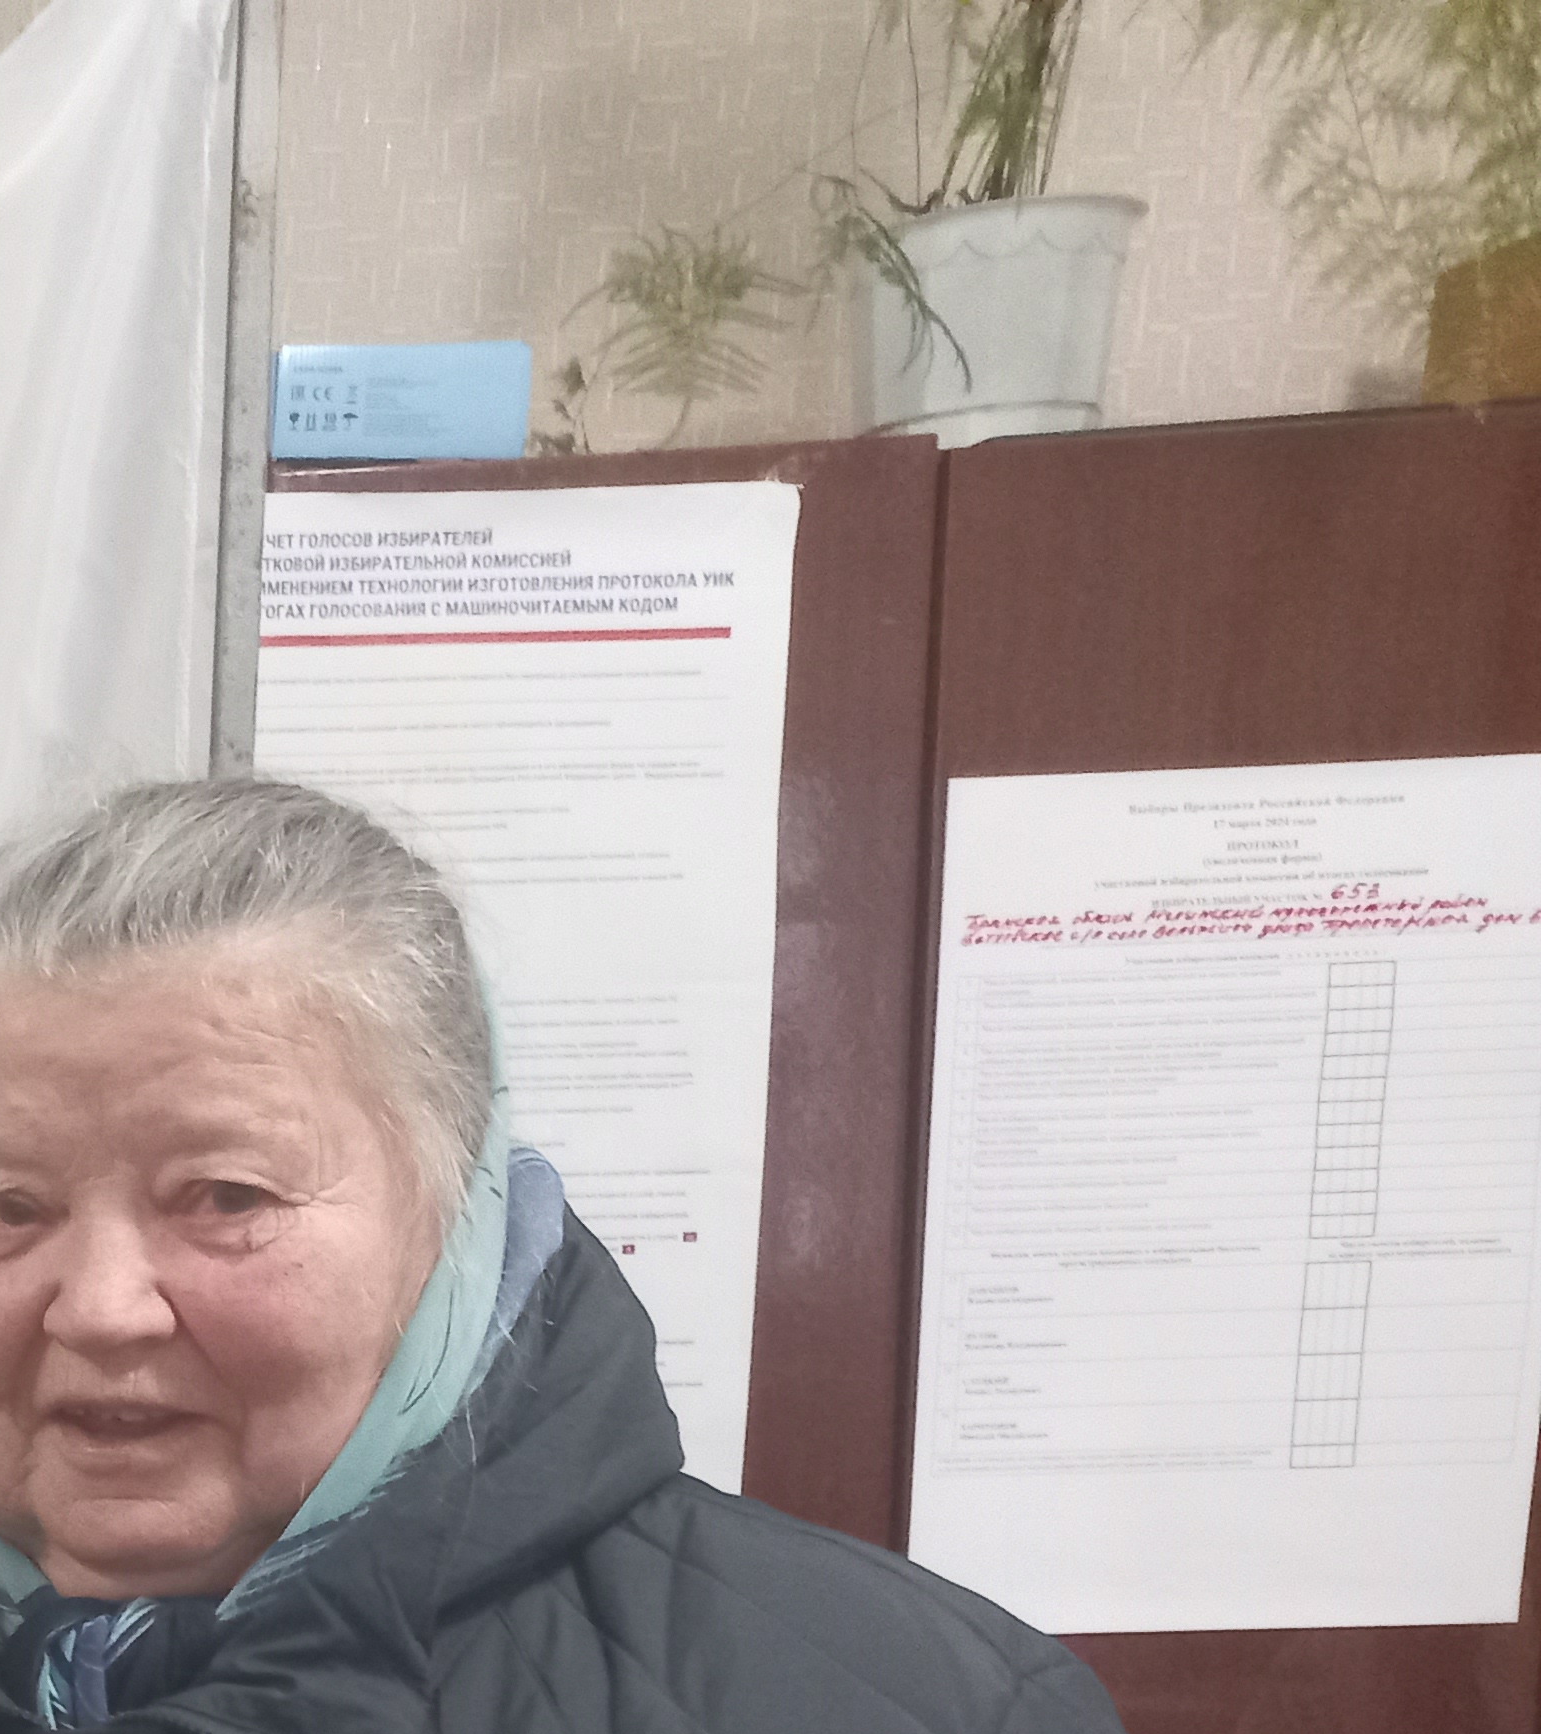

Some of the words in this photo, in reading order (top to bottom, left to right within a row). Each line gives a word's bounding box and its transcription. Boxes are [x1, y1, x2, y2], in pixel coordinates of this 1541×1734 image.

[299, 532, 373, 549] ГОЛОСОВ
[377, 528, 493, 547] ИЗБИРАТЕЛЕЙ
[330, 553, 467, 571] ИЗБИРАТЕЛЬНОЙ
[471, 549, 571, 569] КОМИССИЕЙ
[358, 578, 463, 595] ТЕХНОЛОГИИ
[468, 575, 594, 593] ИЗГОТОВЛЕНИЯ
[598, 572, 698, 590] ПРОТОКОЛА
[702, 571, 735, 587] УИК
[262, 603, 305, 620] ОГАХ
[309, 601, 426, 618] ГОЛОСОВАНИЯ
[431, 601, 442, 616] С
[445, 597, 614, 616] МАШИНОЧИТАЕМЫМ
[618, 596, 679, 615] КОДОМ
